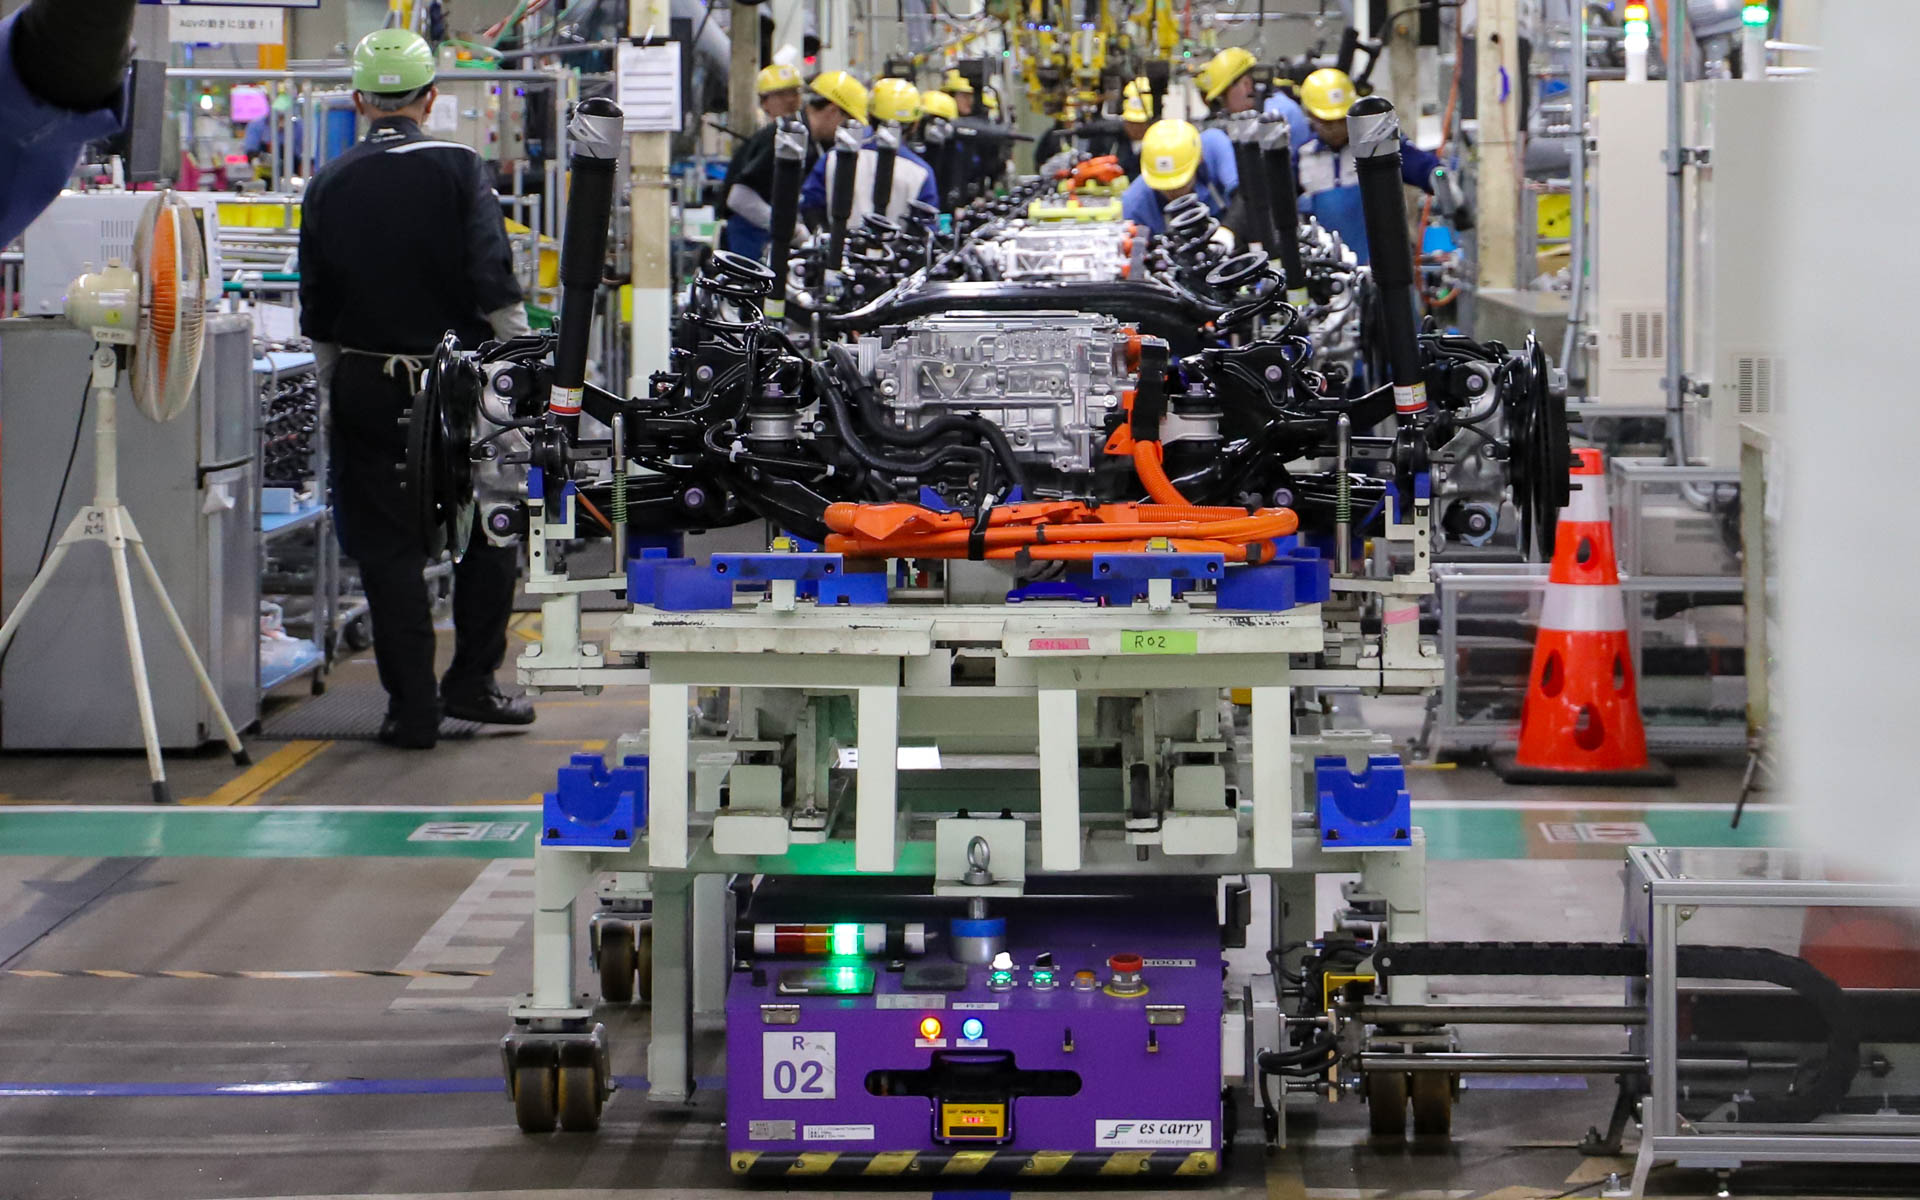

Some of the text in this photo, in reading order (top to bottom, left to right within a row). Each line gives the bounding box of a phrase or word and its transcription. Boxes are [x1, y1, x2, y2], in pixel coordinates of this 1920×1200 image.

[792, 1035, 805, 1050] R
[773, 1060, 824, 1093] 02
[1139, 1123, 1203, 1138] es carry
